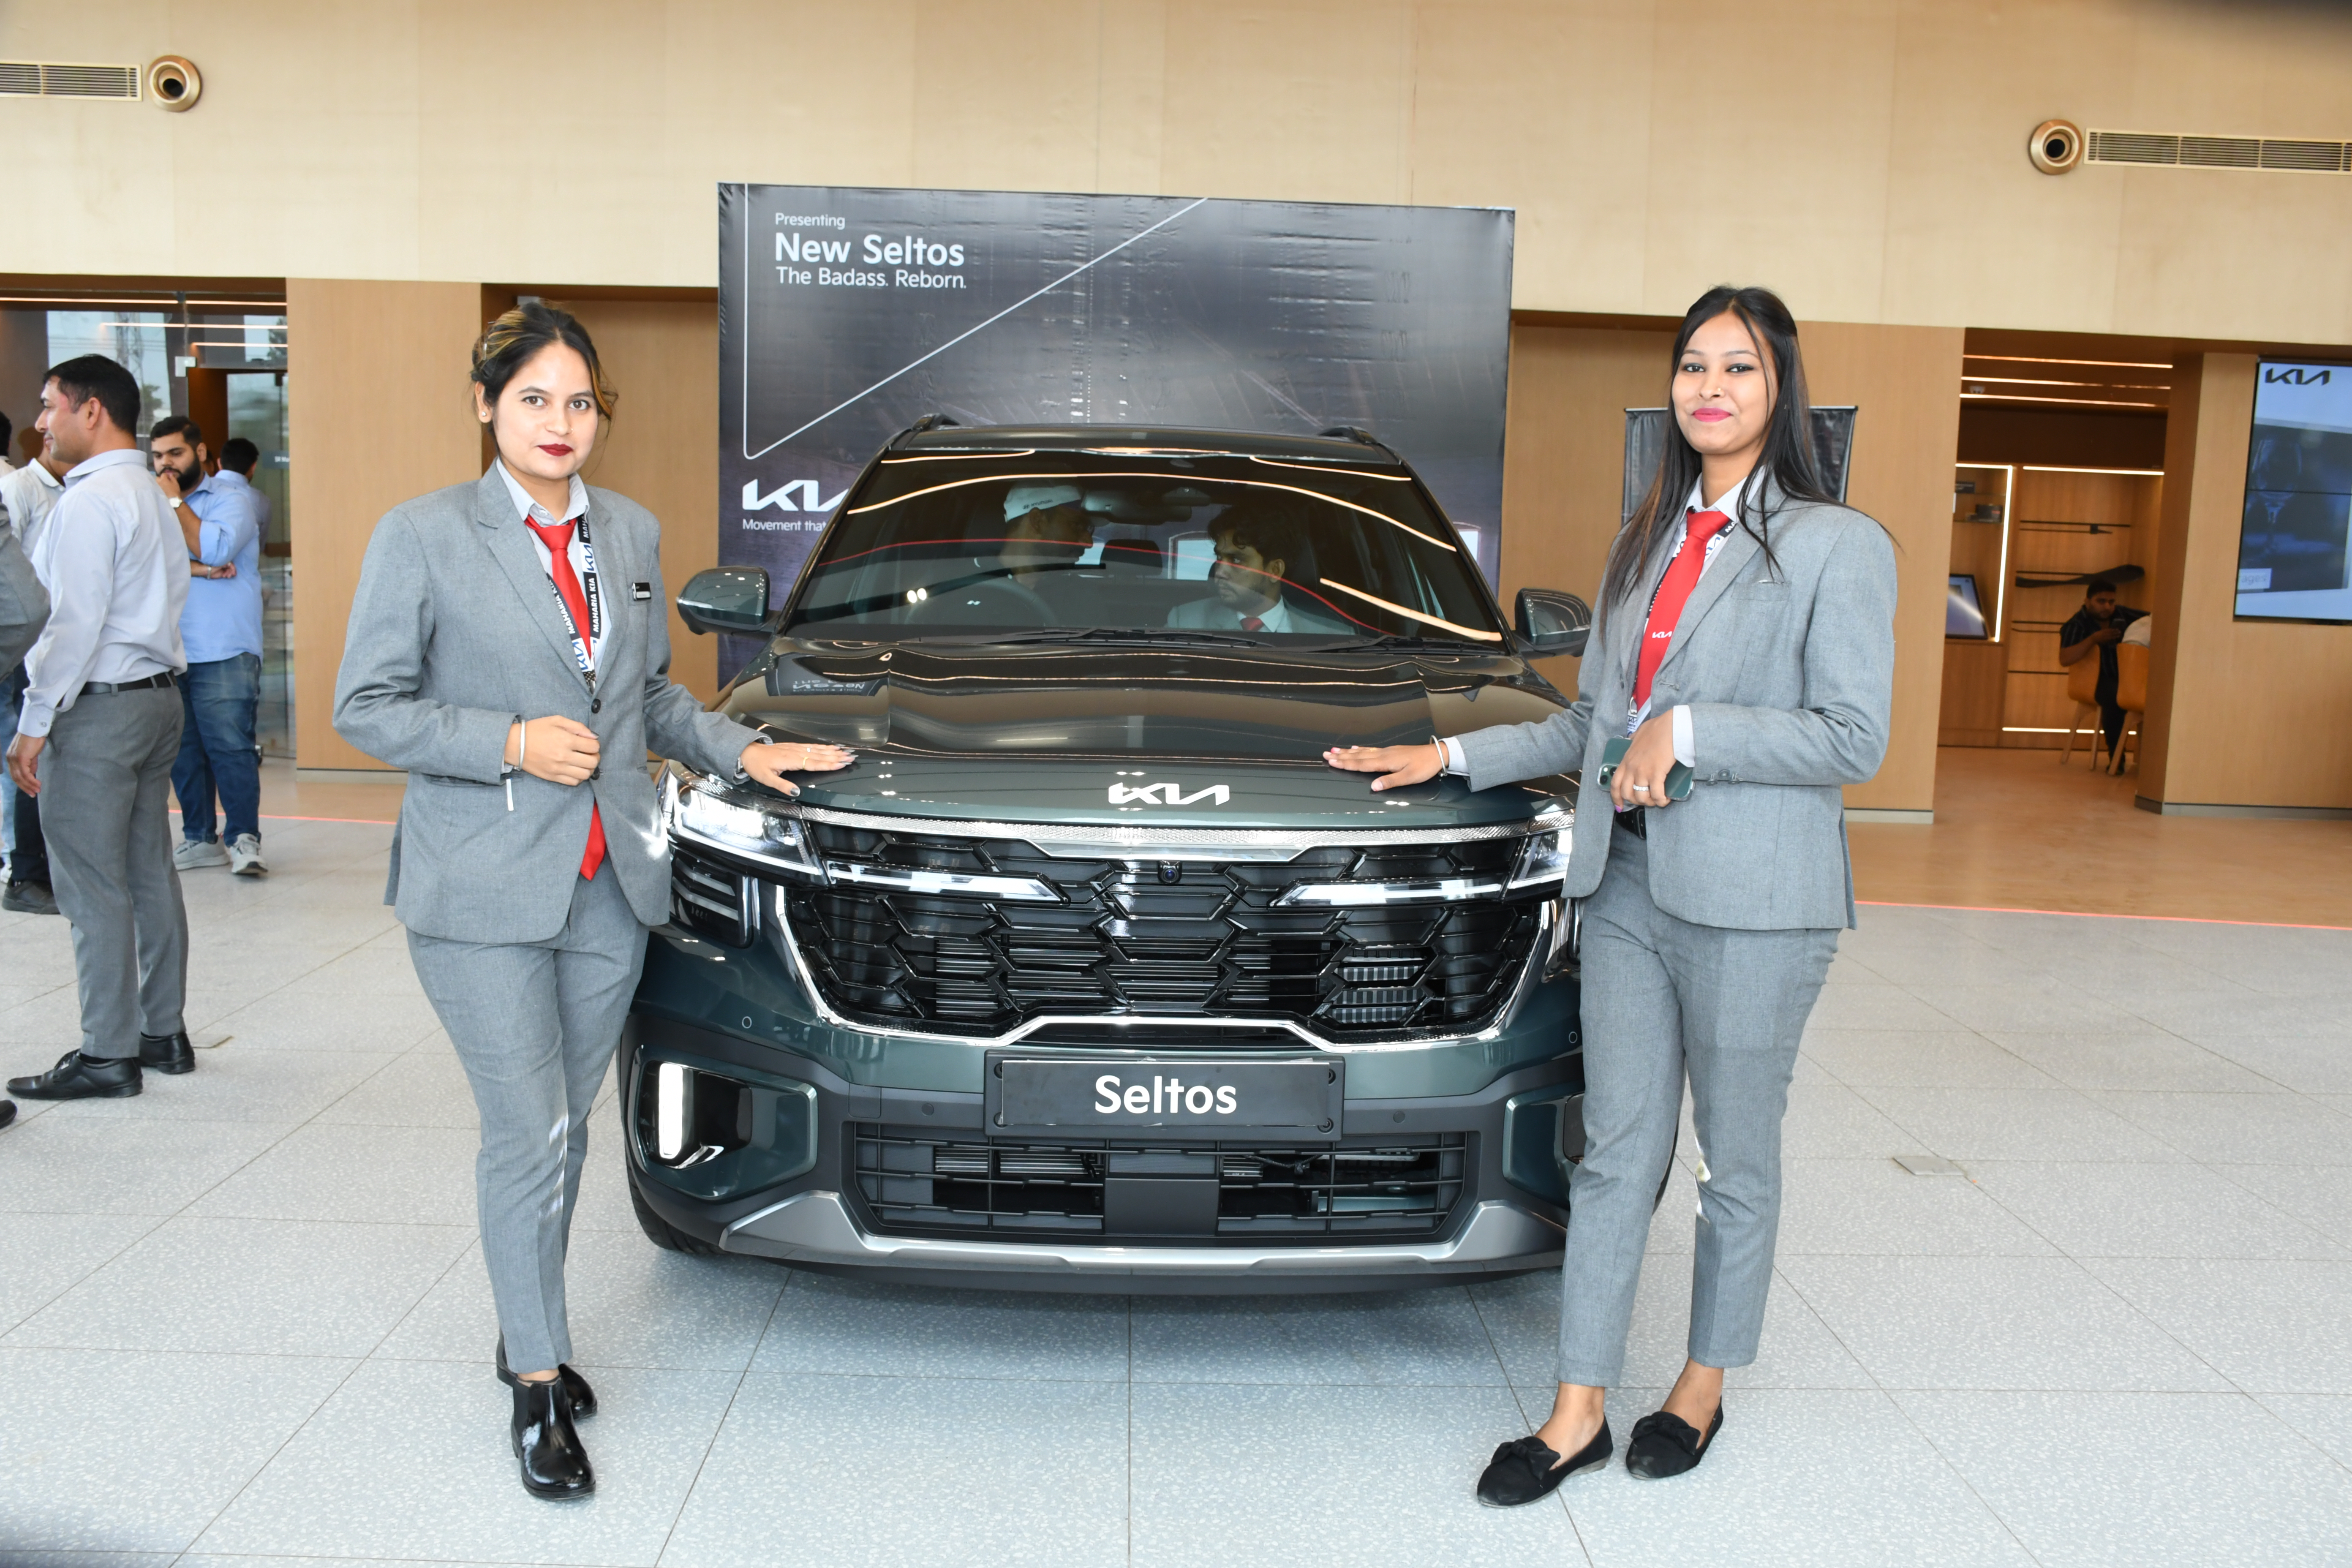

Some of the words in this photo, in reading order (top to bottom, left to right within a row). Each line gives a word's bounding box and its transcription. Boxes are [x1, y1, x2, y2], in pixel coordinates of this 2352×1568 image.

[775, 212, 845, 230] Presenting
[775, 232, 851, 263] New
[863, 234, 964, 267] Seltos
[776, 266, 811, 285] The
[819, 267, 888, 286] Badass.
[896, 270, 966, 289] Reborn.
[2265, 368, 2331, 385] KIA
[743, 519, 802, 531] Movement
[804, 520, 827, 532] that
[588, 578, 596, 591] KIA
[591, 593, 599, 632] MAHARIA
[1108, 782, 1230, 806] KIA
[1095, 1075, 1237, 1114] Seltos
